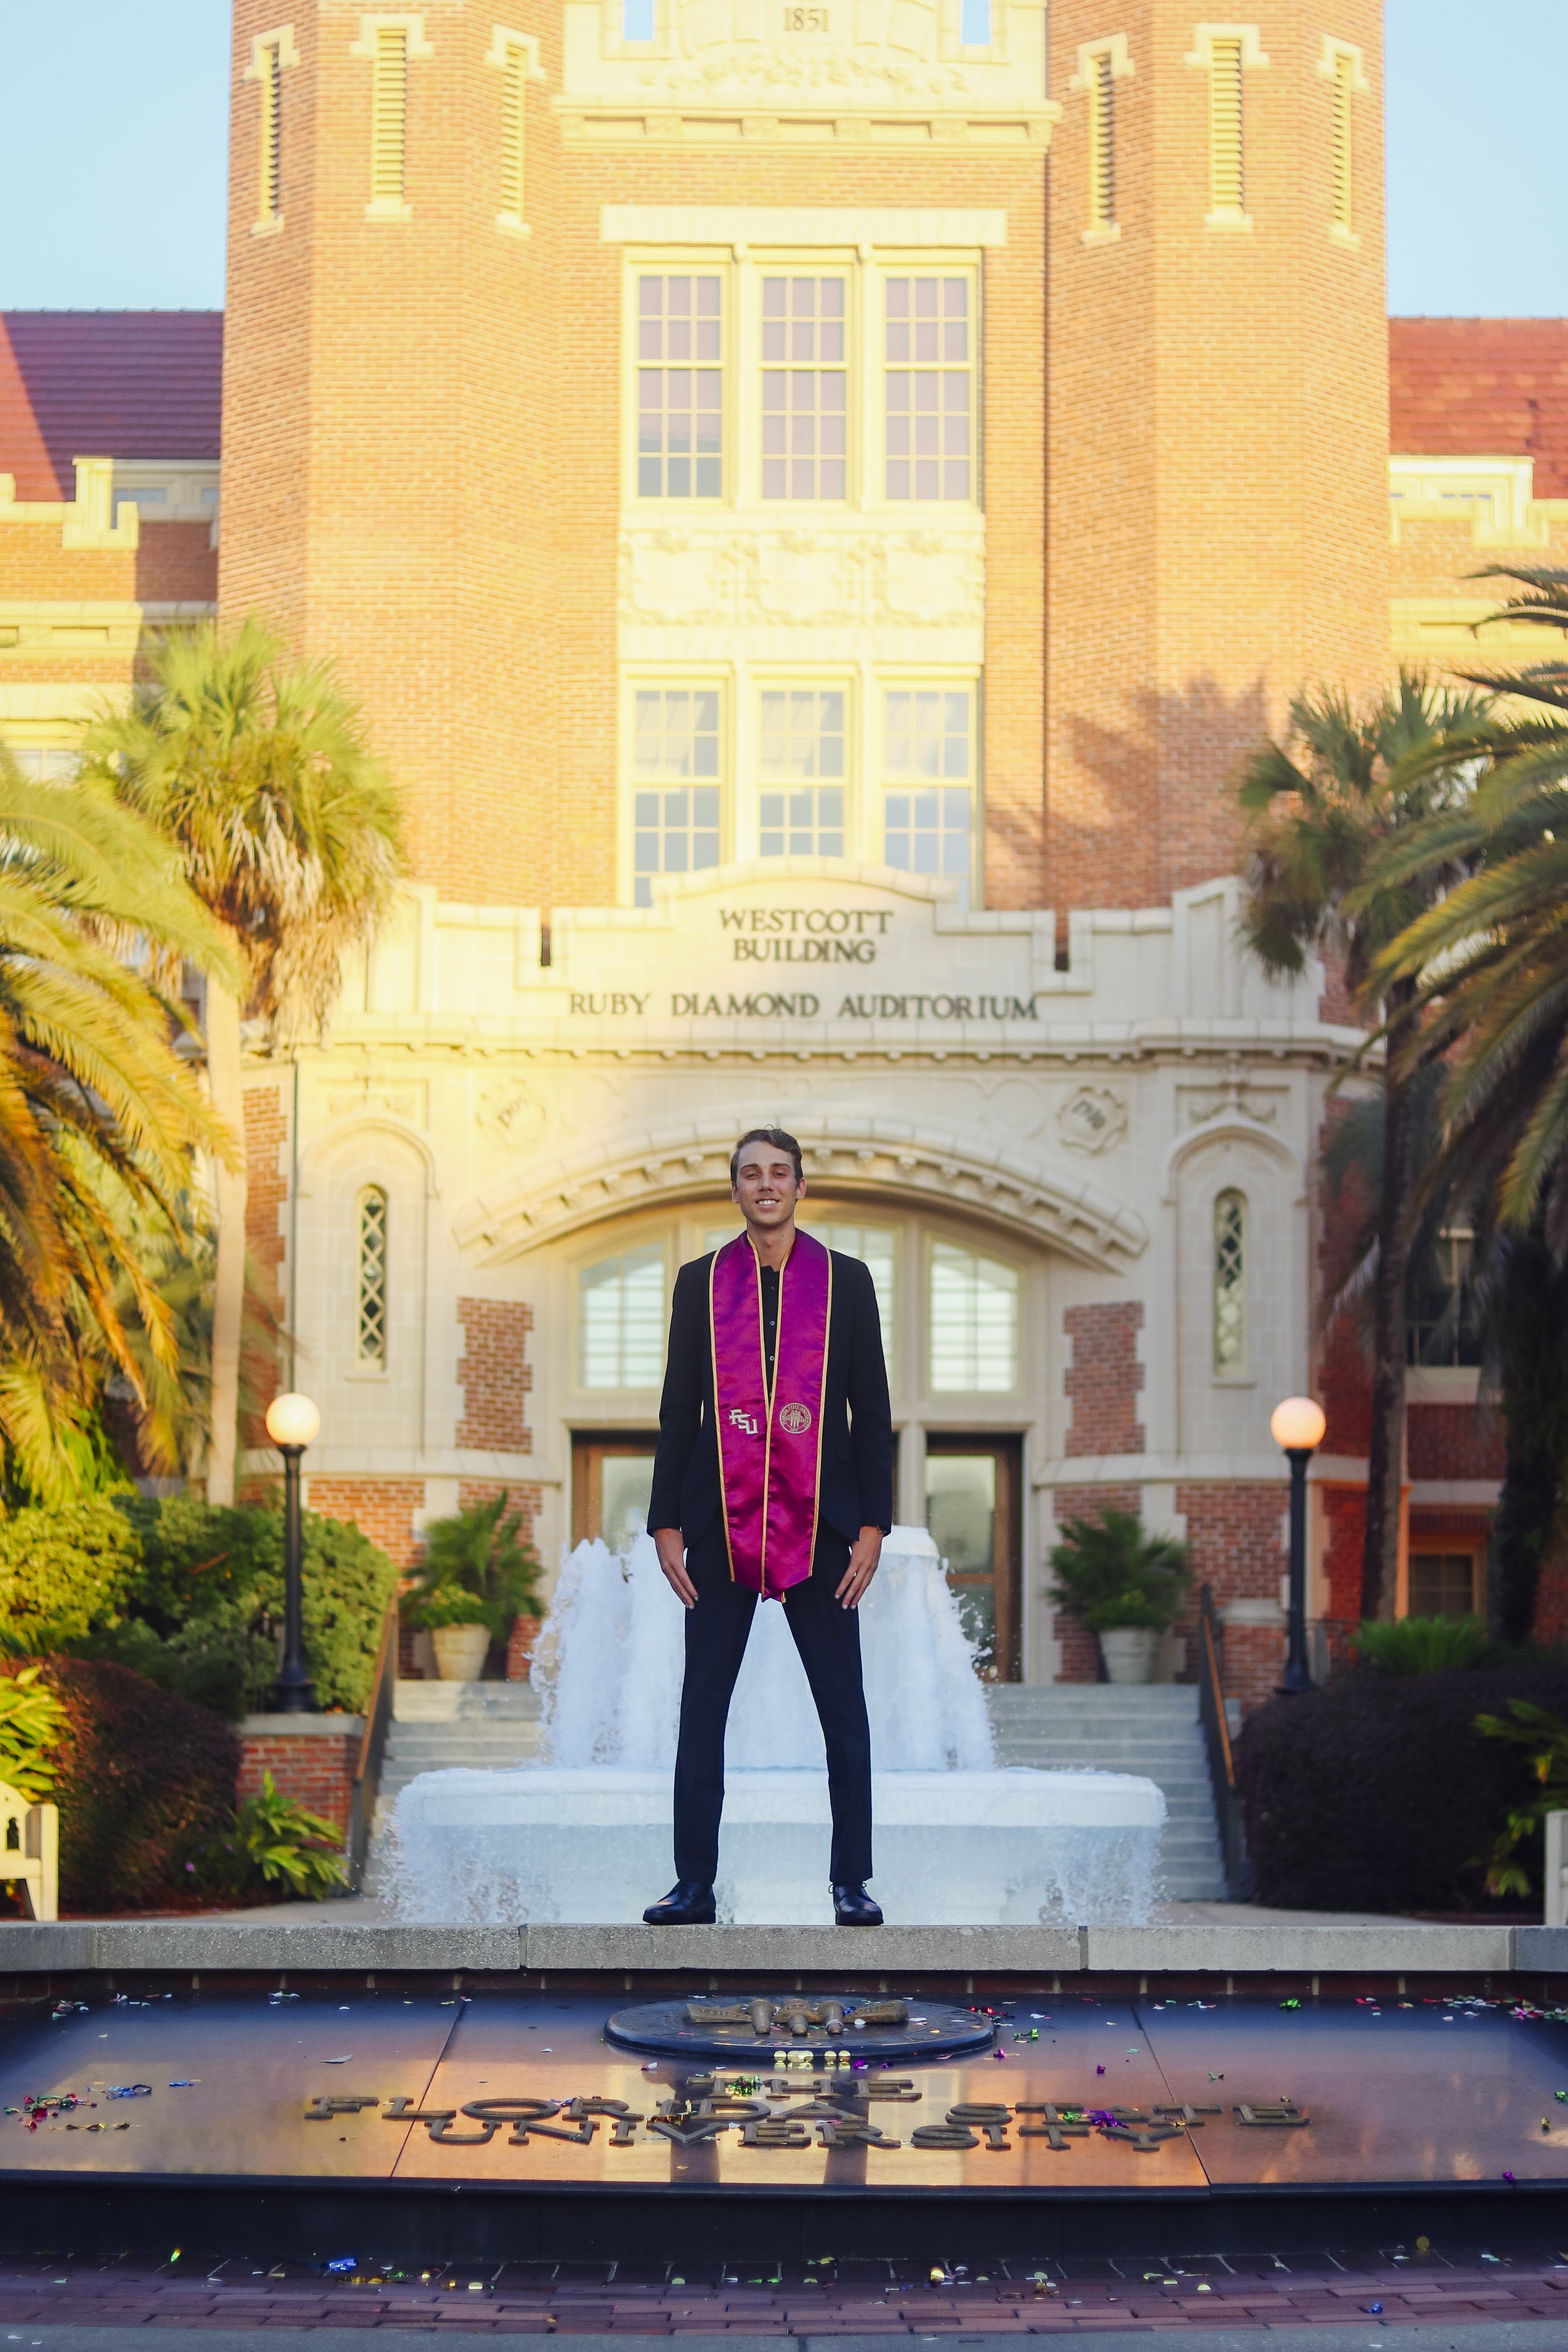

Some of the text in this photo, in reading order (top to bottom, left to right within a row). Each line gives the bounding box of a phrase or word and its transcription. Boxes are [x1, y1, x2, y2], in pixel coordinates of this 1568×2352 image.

[784, 8, 829, 32] 1851
[719, 908, 894, 934] WESTCOTT
[733, 938, 876, 963] BUILDING
[569, 992, 1039, 1020] RUBY DIAMOND AUDITORIUM
[728, 1409, 759, 1435] FSU
[686, 2075, 923, 2101] THE
[304, 2096, 1311, 2127] FLORIDA STATE
[424, 2119, 1185, 2152] UNIVERSITY
